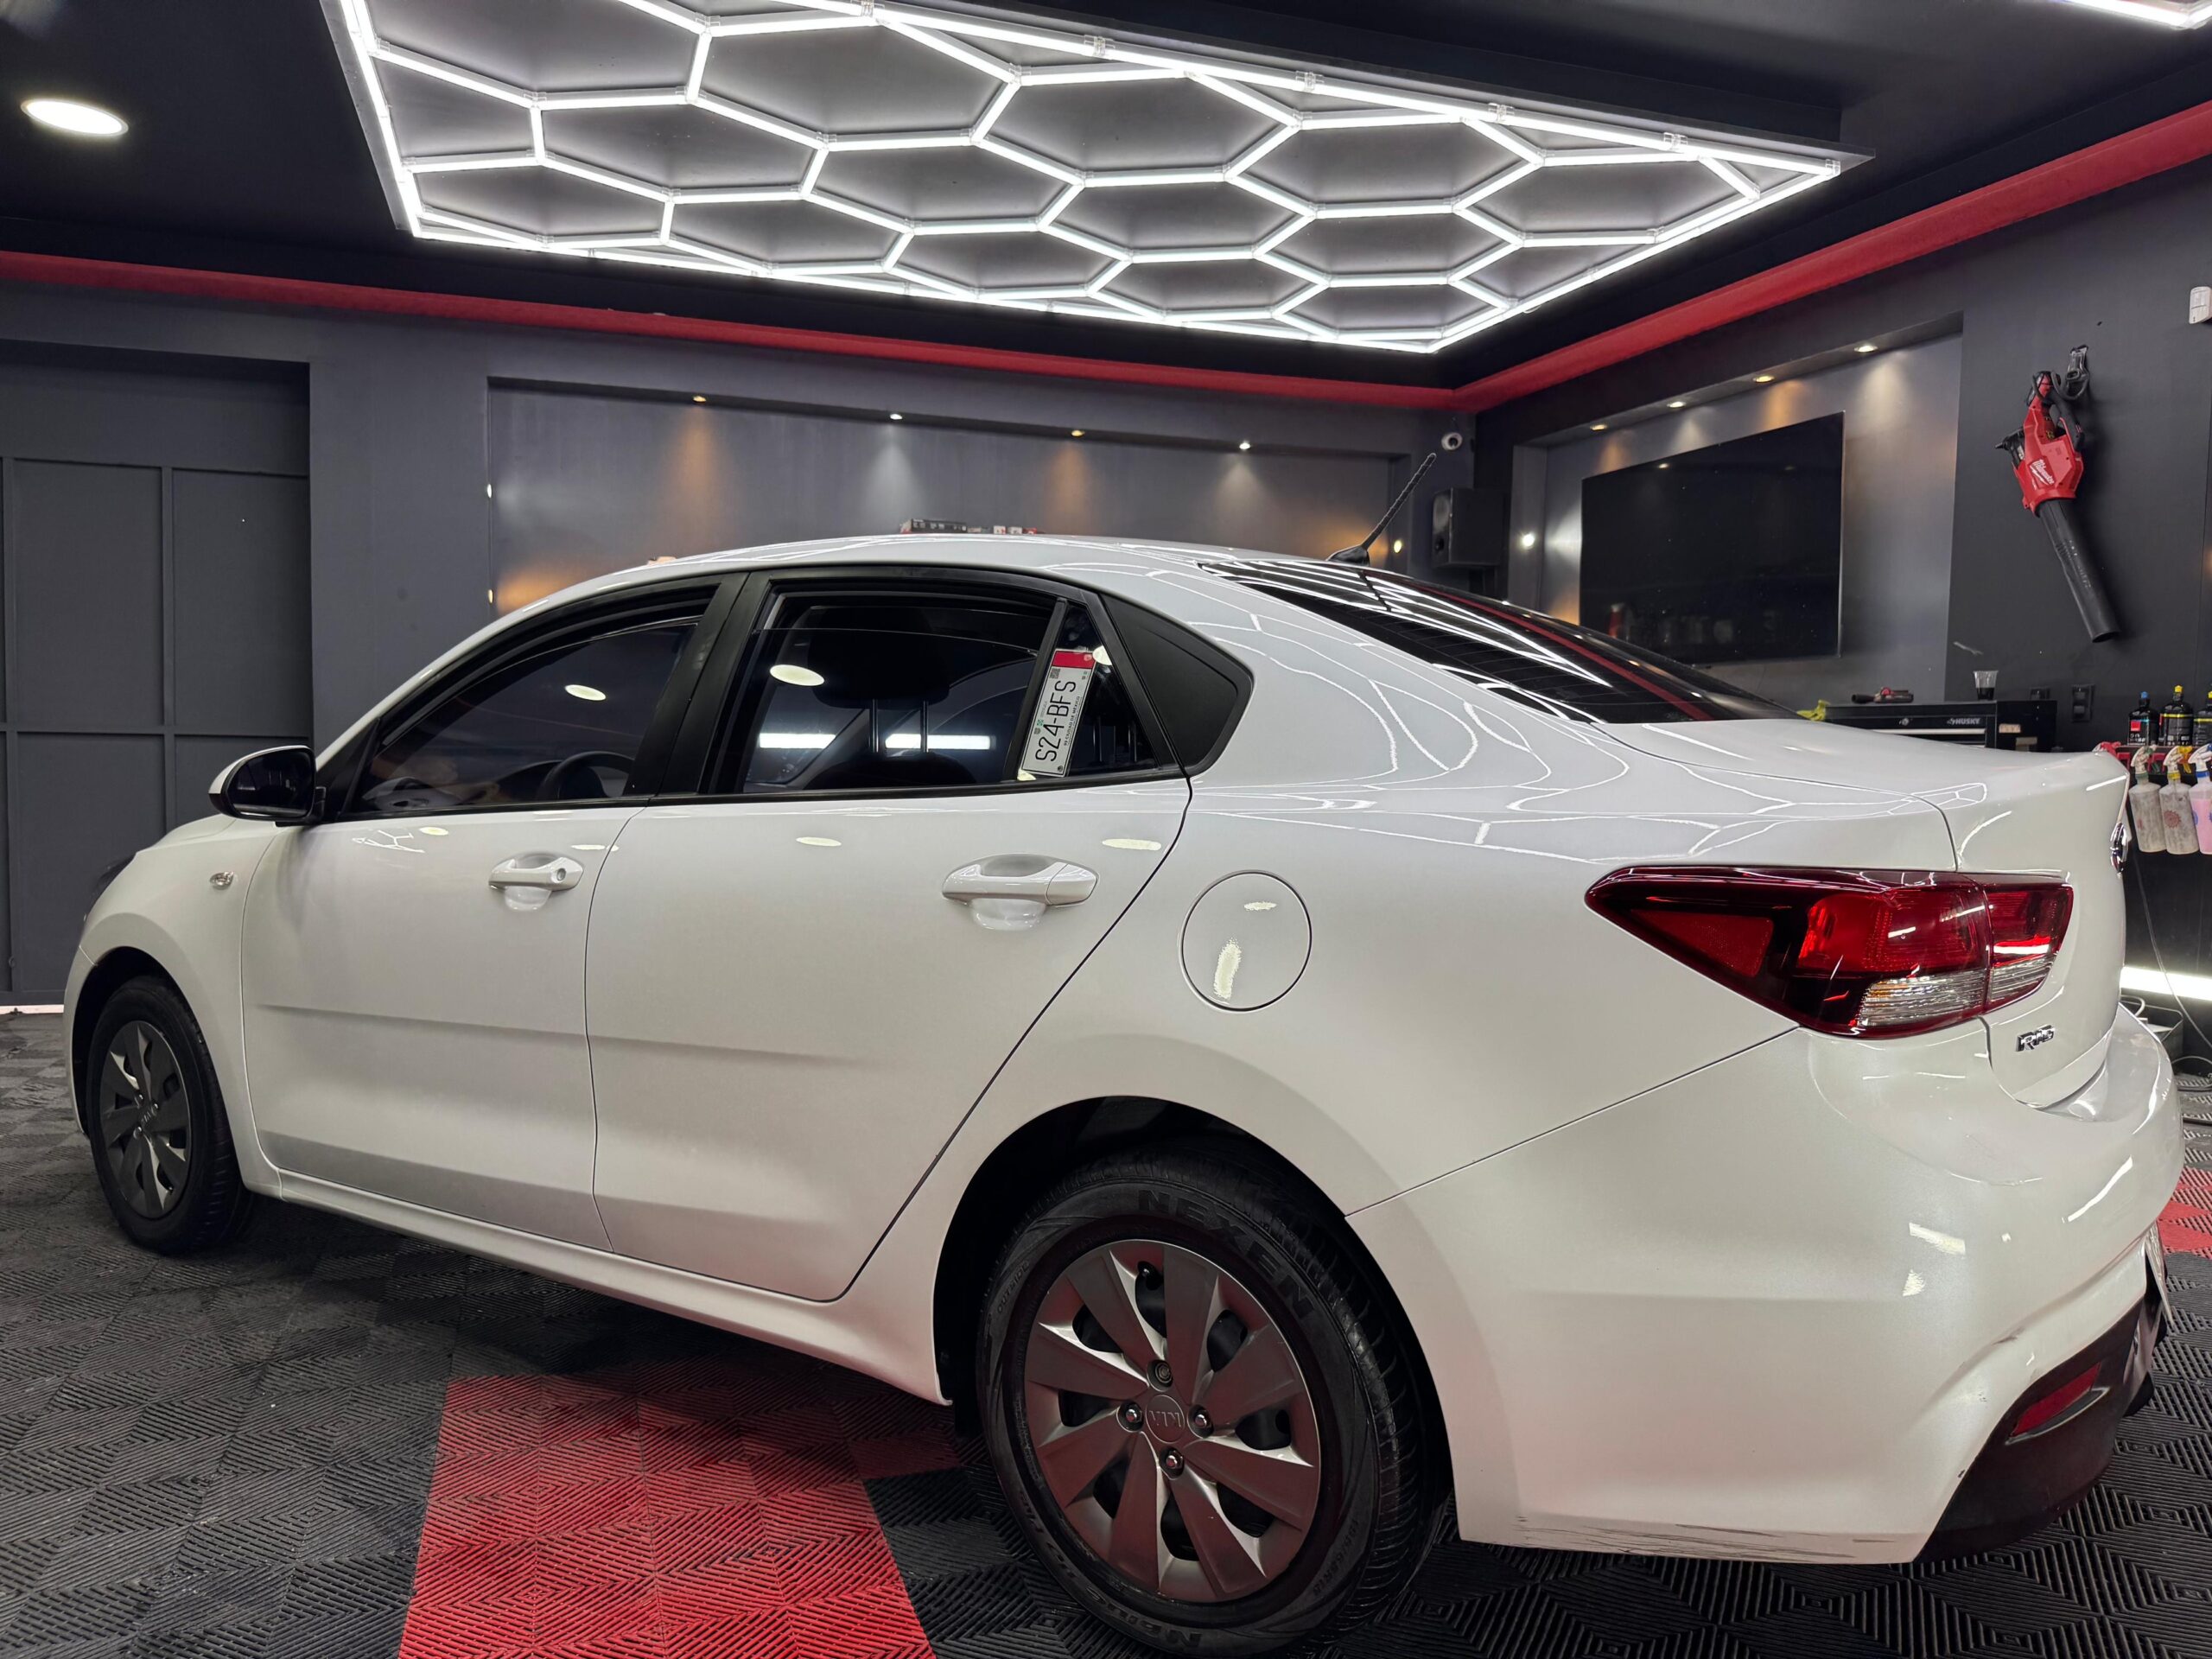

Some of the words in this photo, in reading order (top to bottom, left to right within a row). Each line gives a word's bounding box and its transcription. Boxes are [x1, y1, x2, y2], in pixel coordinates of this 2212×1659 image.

[1034, 680, 1077, 762] S24-BFS
[1955, 717, 1981, 726] HUSKY
[1137, 1188, 1316, 1320] NEXEN
